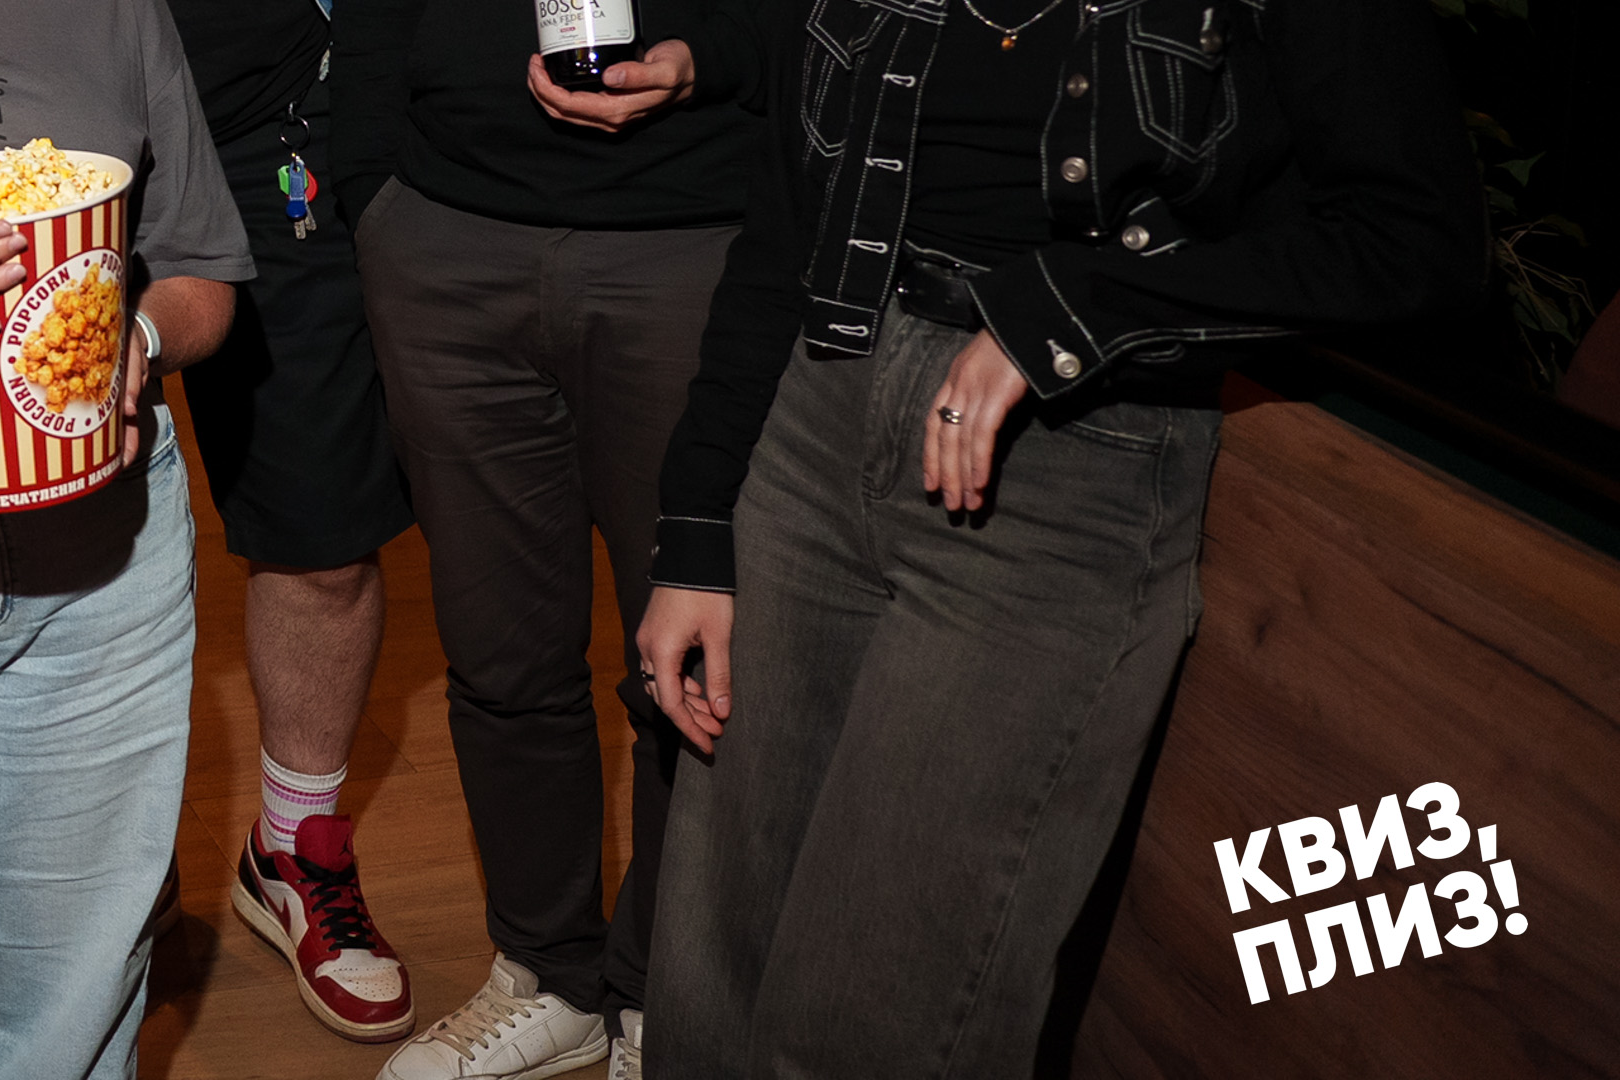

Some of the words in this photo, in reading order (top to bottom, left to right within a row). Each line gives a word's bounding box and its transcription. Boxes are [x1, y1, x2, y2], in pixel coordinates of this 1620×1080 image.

[560, 11, 606, 23] FEDECA
[7, 267, 71, 347] POPCORN
[8, 376, 76, 433] POPCORN
